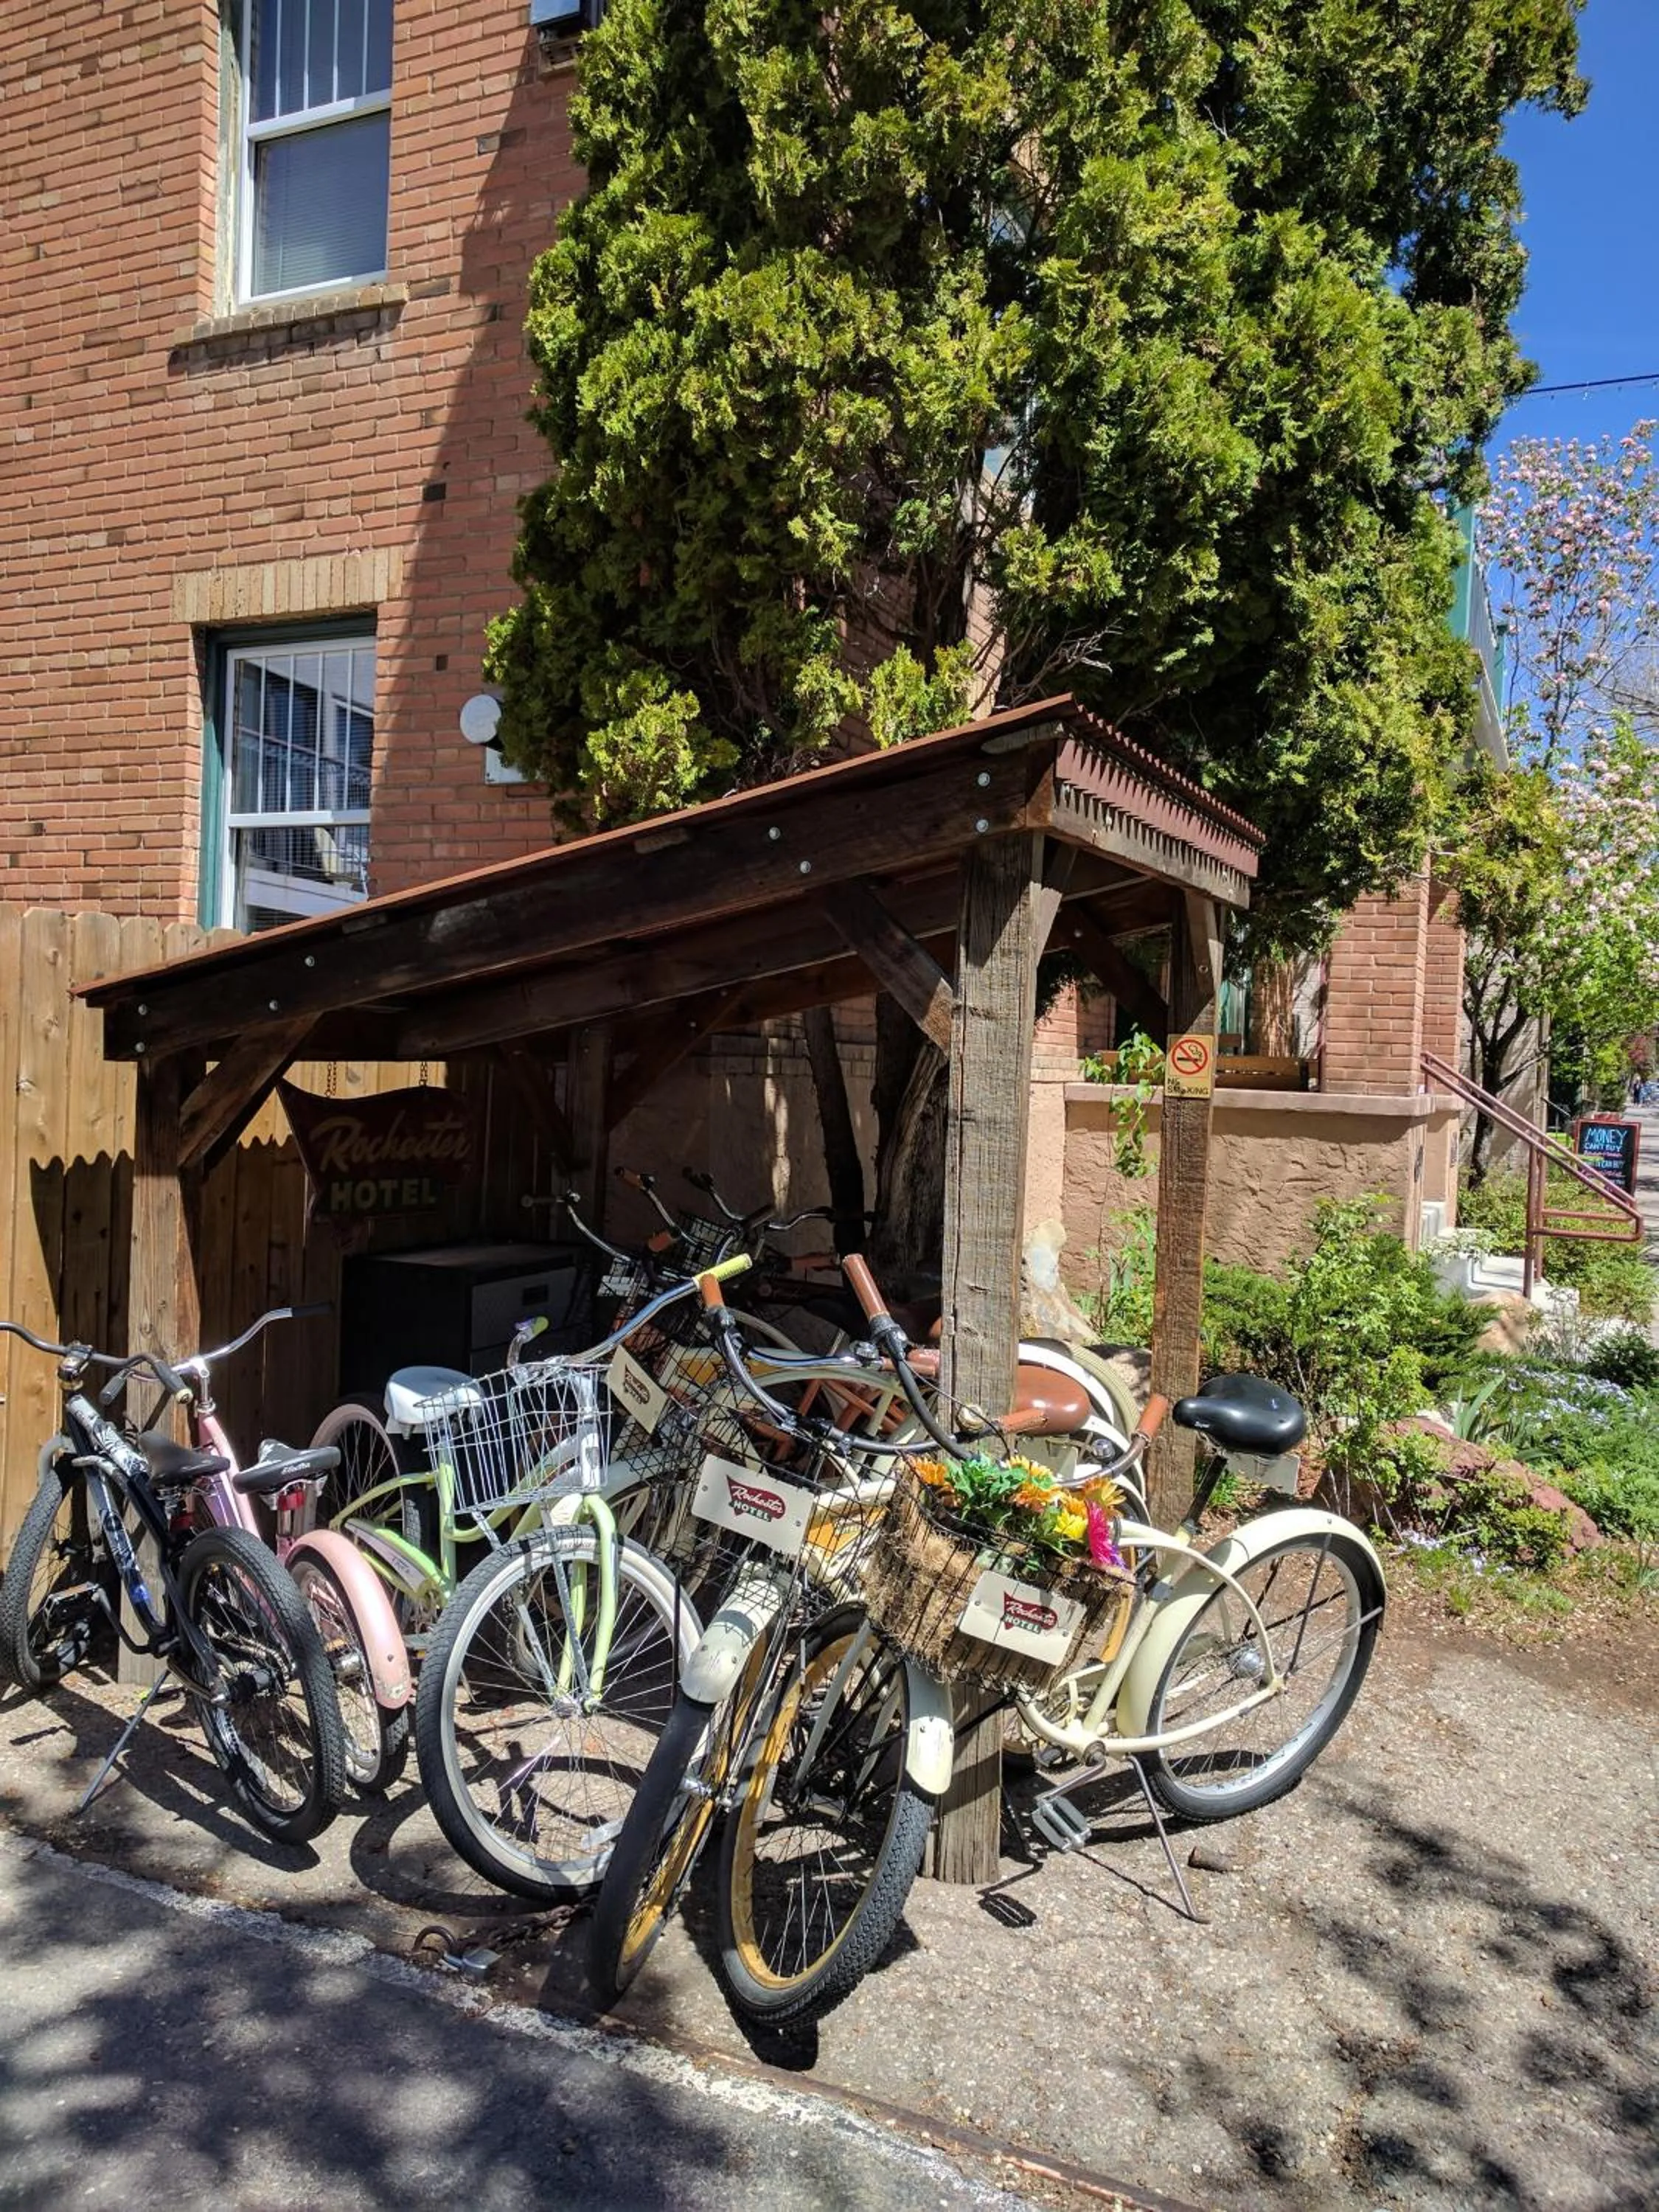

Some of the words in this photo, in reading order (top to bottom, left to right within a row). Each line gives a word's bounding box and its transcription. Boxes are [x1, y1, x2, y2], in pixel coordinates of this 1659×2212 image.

[1167, 1085, 1209, 1095] SMOKING
[308, 1109, 472, 1173] Rochester
[1585, 1127, 1628, 1146] MONEY
[1605, 1144, 1623, 1152] BUY
[329, 1178, 438, 1211] HOTEL
[731, 1485, 784, 1514] Rochester
[734, 1501, 771, 1522] HOTEL
[1004, 1614, 1040, 1633] HOTEL
